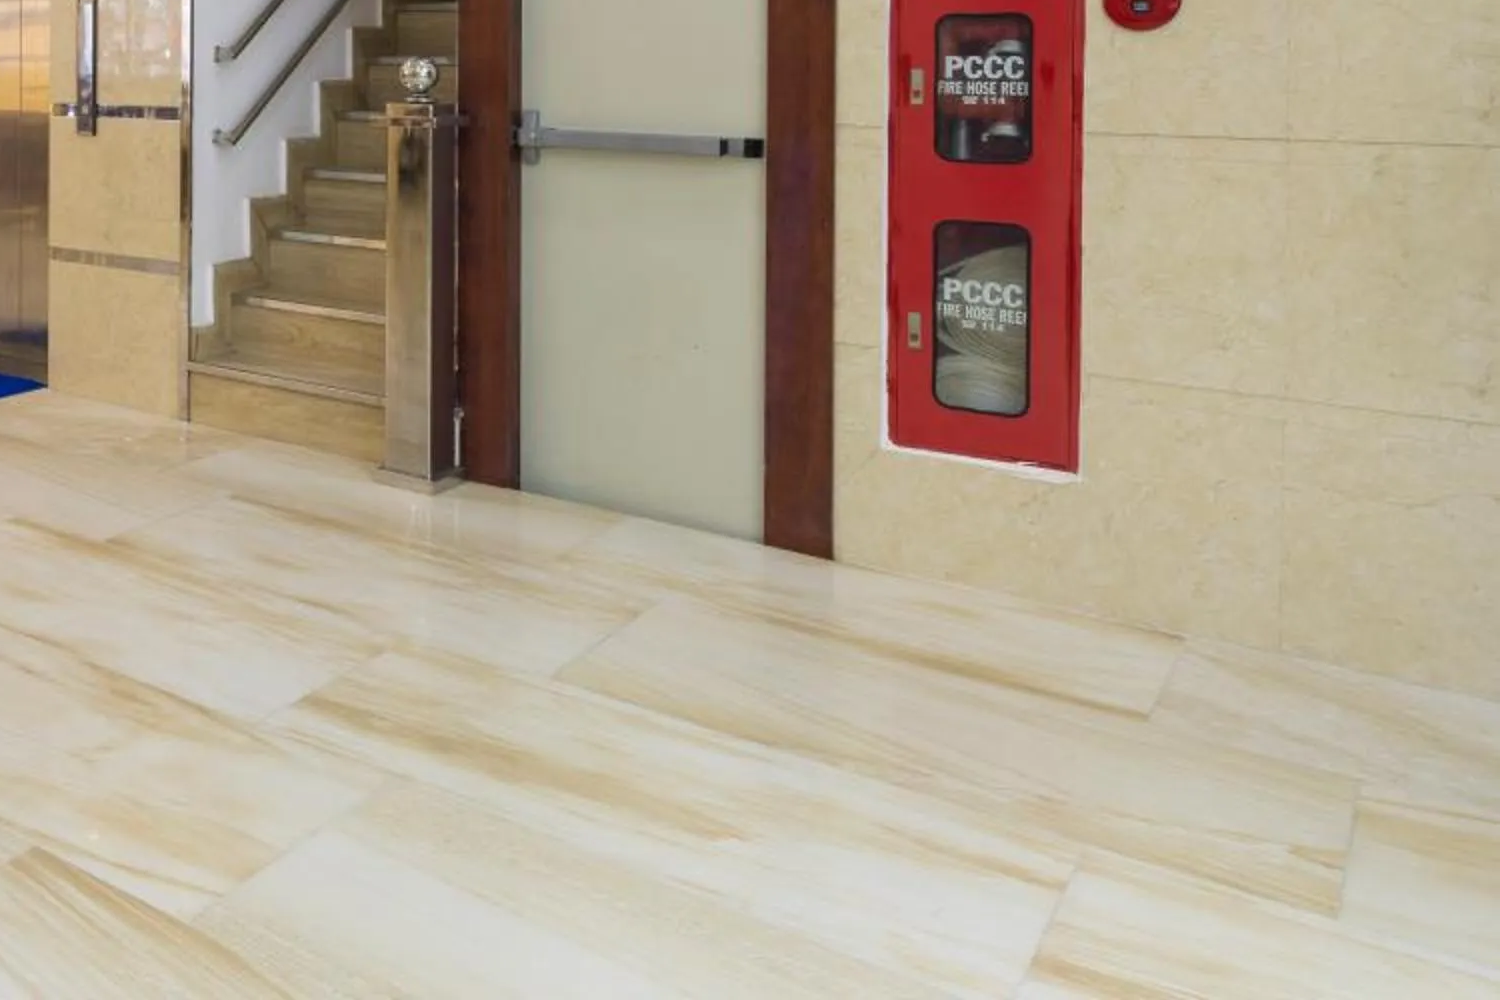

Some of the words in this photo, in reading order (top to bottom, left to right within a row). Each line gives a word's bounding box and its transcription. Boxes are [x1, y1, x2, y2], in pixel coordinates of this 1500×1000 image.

[944, 55, 1025, 80] PCCC
[937, 80, 963, 96] FIRE
[966, 81, 997, 97] HOSE
[943, 278, 1024, 308] PCCC
[965, 304, 995, 322] HOSE
